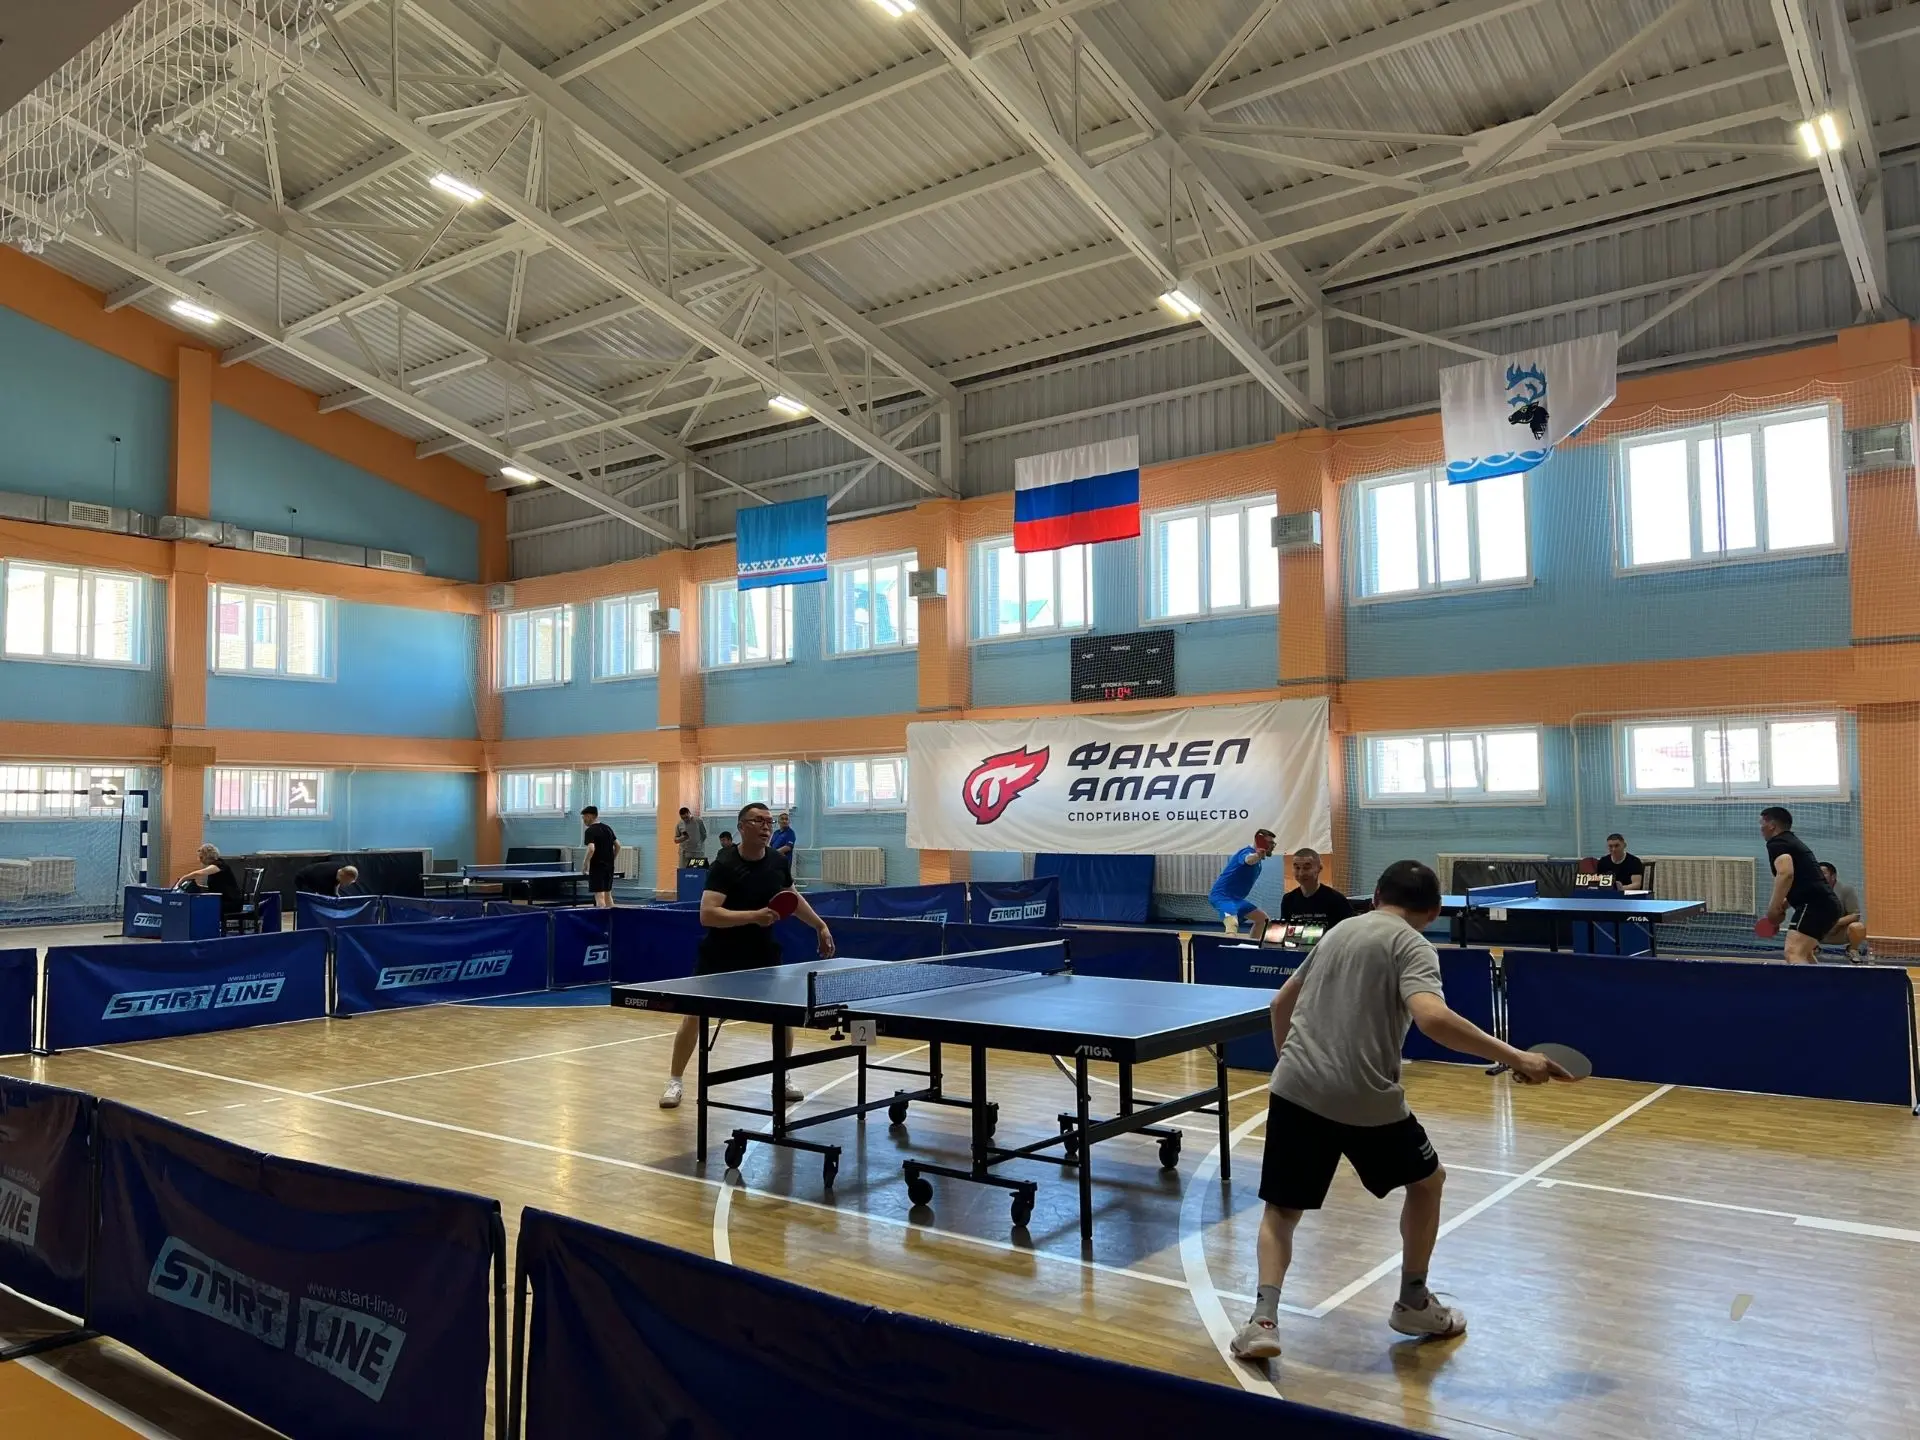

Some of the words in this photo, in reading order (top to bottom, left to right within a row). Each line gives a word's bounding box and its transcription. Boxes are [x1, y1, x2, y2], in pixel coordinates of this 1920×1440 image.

[1067, 738, 1250, 770] ФАКЕЛ
[1068, 773, 1216, 802] ЯМАЛ
[1067, 810, 1160, 822] СПОРТИВНОЕ
[1166, 809, 1249, 822] ОБЩЕСТВО
[990, 907, 1021, 920] START
[1025, 905, 1045, 917] LINE
[381, 964, 459, 986] START
[463, 956, 511, 977] LINE
[109, 986, 215, 1015] START
[219, 982, 278, 1004] LINE
[624, 997, 649, 1008] EXPERT
[858, 1025, 867, 1042] 2
[155, 1248, 282, 1334] START
[303, 1309, 393, 1385] LINE
[306, 1279, 408, 1325] www.start-line.ru
